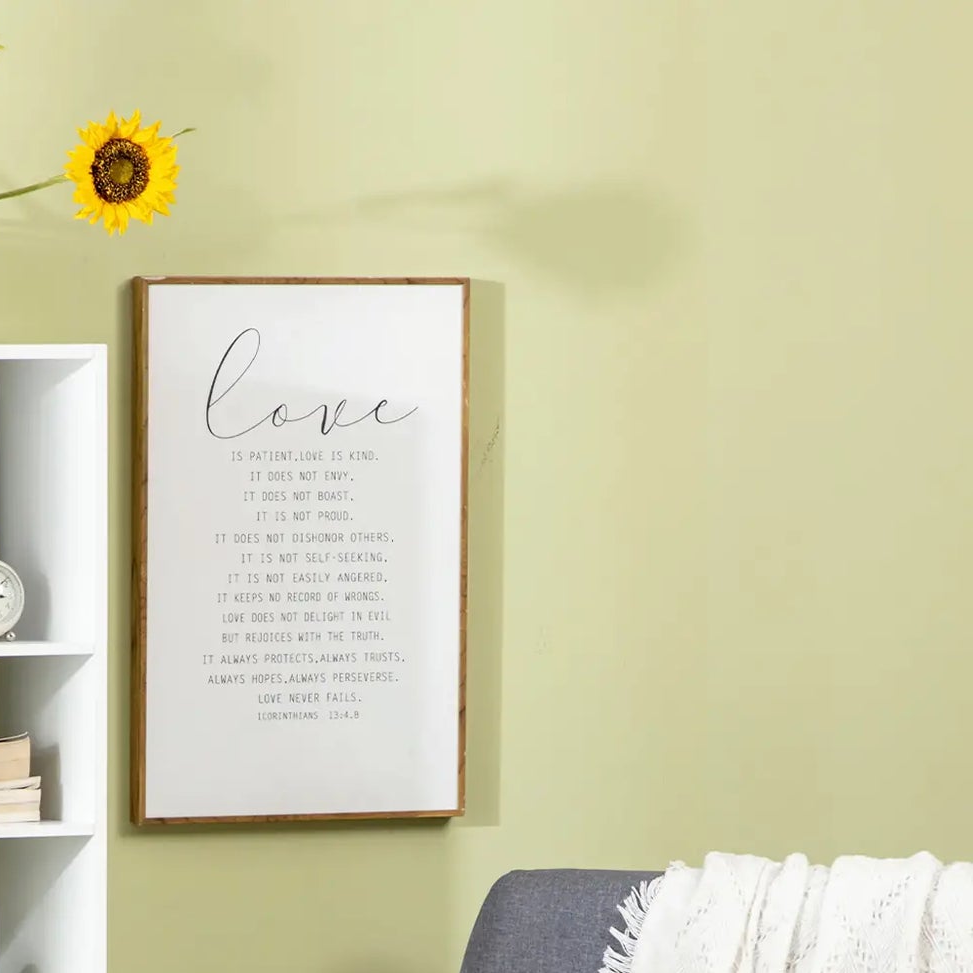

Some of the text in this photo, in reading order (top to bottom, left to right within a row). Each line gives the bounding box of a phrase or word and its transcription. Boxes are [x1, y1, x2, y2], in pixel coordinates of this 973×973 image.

[206, 328, 419, 439] love
[232, 451, 243, 462] IS
[332, 450, 342, 461] IS
[251, 471, 261, 482] IT
[268, 471, 293, 482] DOES
[300, 470, 317, 481] NOT
[244, 491, 255, 502] IT
[262, 491, 286, 502] DOES
[293, 491, 311, 502] NOT
[257, 511, 267, 522] IT
[276, 511, 286, 522] IS
[293, 511, 311, 522] NOT
[216, 533, 226, 544] IT
[234, 533, 259, 544] DOES
[267, 533, 284, 544] NOT
[292, 532, 344, 543] DISHONOR
[242, 553, 253, 564] IT
[261, 553, 272, 564] IS
[279, 553, 298, 564] NOT
[228, 573, 239, 584] IT
[248, 573, 259, 584] IS
[266, 573, 284, 584] NOT
[293, 572, 330, 583] EASILY
[218, 592, 227, 603] IT
[234, 592, 263, 603] KEEPS
[269, 592, 281, 603] NO
[287, 591, 321, 602] RECORD
[327, 591, 338, 602] OF
[223, 611, 391, 623] LOVE DOES NOT DELIGHT IN EVIL
[222, 632, 239, 643] BUT
[245, 632, 292, 643] REJOICES
[298, 631, 321, 642] WITH
[328, 631, 344, 642] THE
[203, 653, 214, 664] IT
[220, 653, 257, 664] ALWAYS
[208, 673, 245, 684] ALWAYS
[258, 693, 282, 704] LOVE
[289, 692, 319, 703] NEVER
